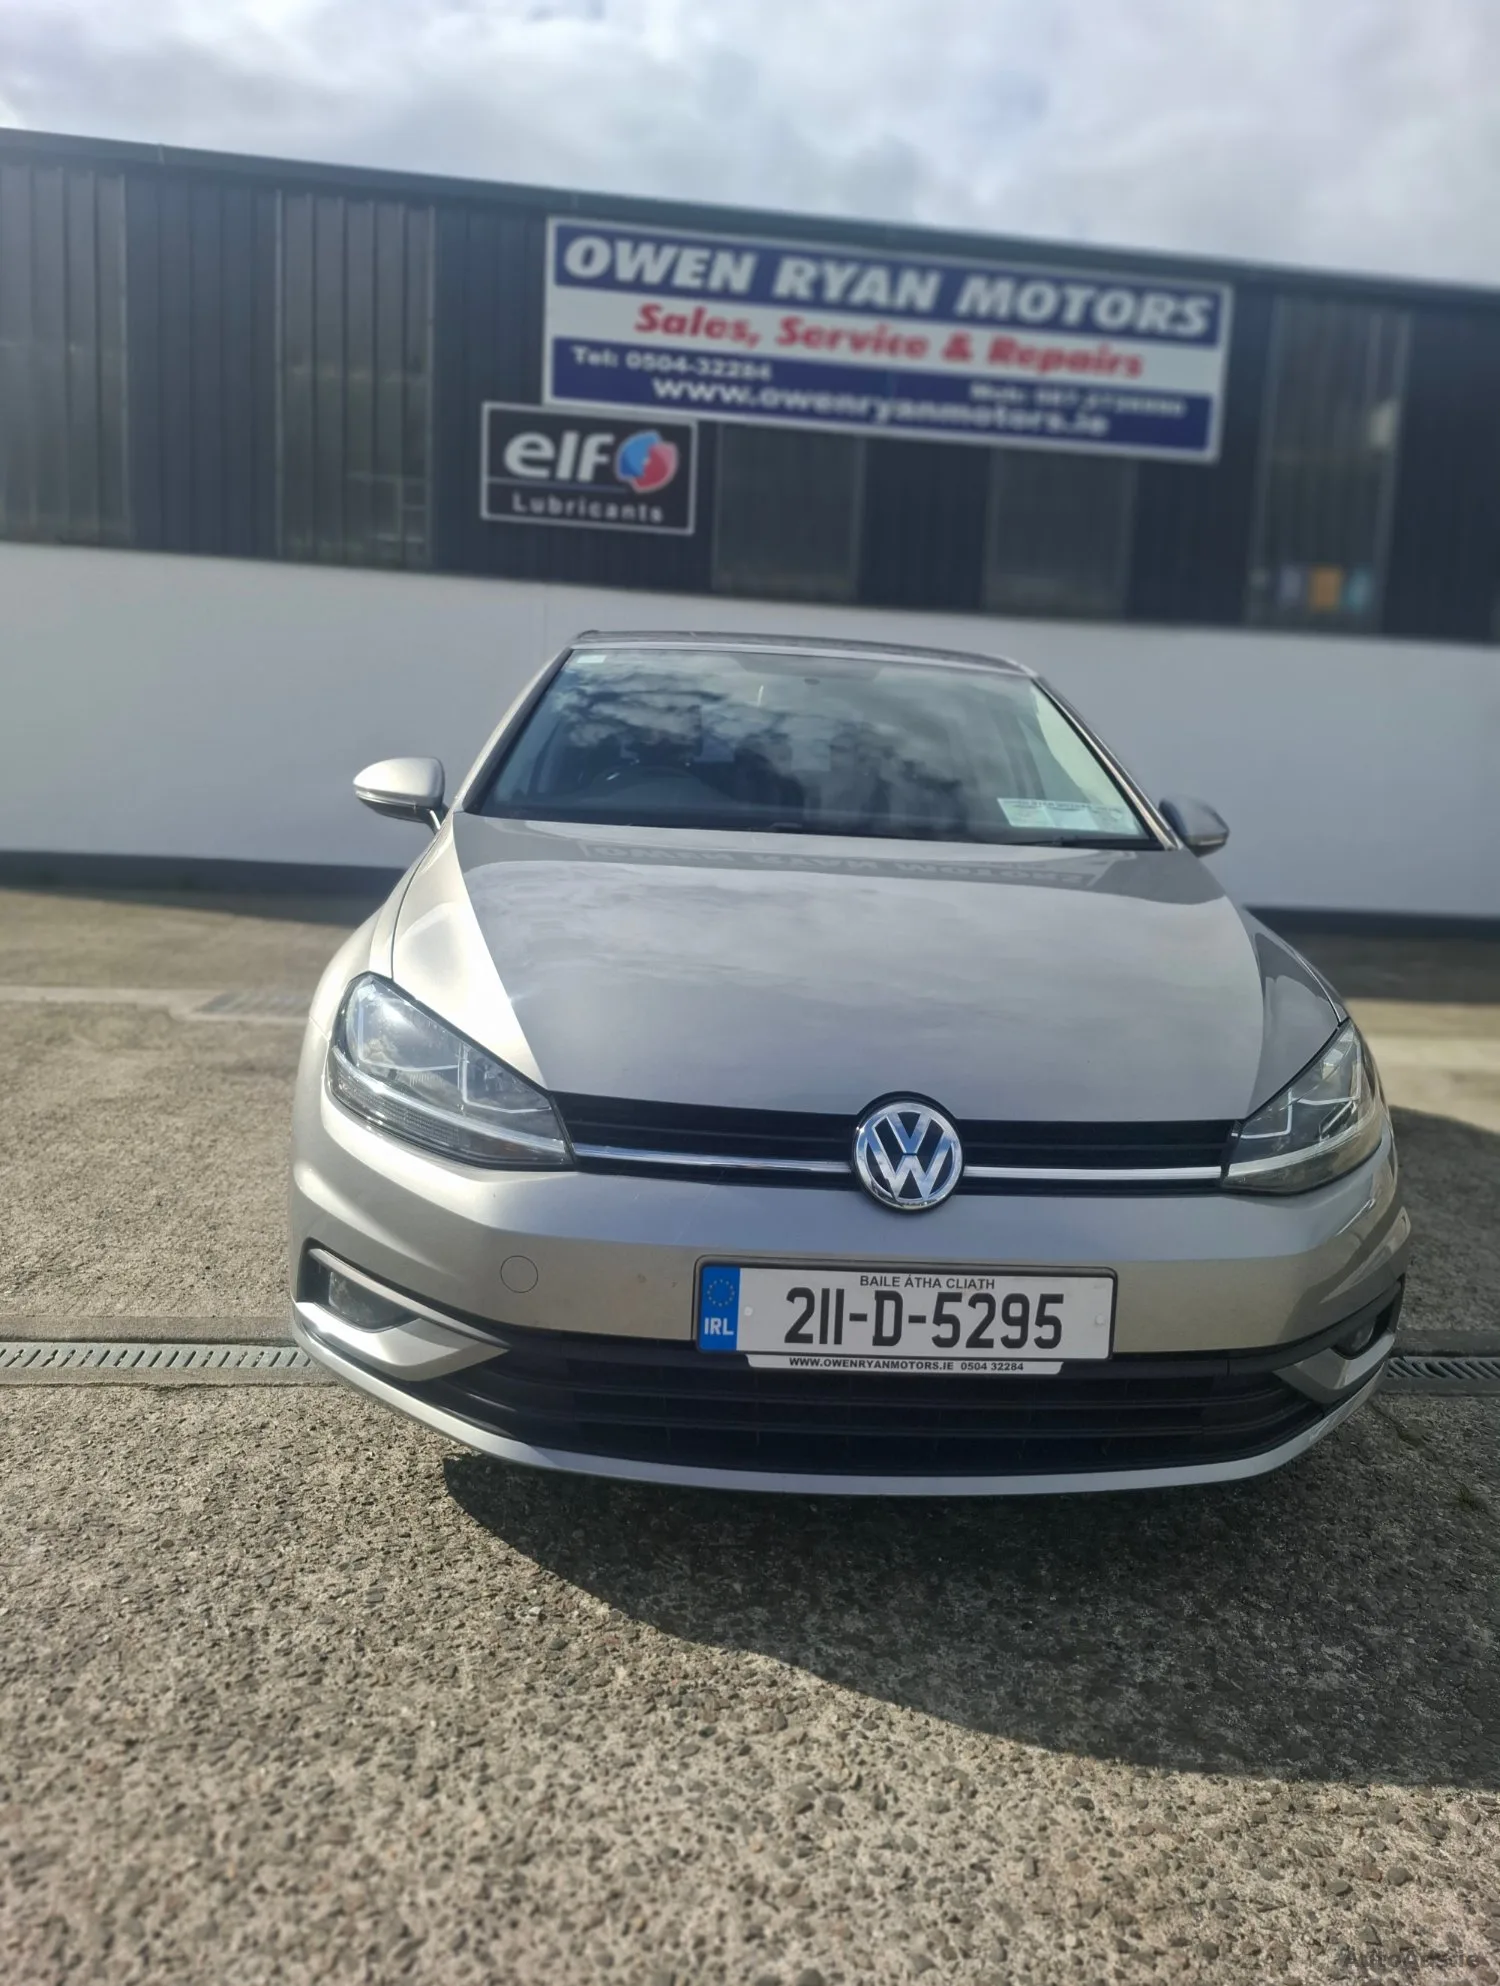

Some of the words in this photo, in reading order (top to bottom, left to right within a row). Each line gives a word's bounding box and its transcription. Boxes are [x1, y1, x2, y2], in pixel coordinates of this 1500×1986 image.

[564, 236, 758, 295] OWEN
[772, 255, 943, 313] RYAN
[954, 274, 1214, 337] MOTORS
[570, 345, 618, 369] Tel:
[635, 302, 761, 348] Sales,
[776, 316, 930, 361] Service
[942, 330, 973, 364] &
[986, 335, 1143, 379] Repairs
[652, 377, 1110, 436] www.owenryanmotors.ie
[504, 430, 615, 481] elf
[512, 491, 664, 524] Lubricants
[860, 1275, 901, 1287] BAILE
[904, 1274, 942, 1289] ÁTHA
[946, 1277, 995, 1290] CLIATH
[704, 1317, 734, 1336] IRL
[784, 1286, 1064, 1350] 211-D-5295
[789, 1357, 954, 1371] WWW.OWENRYANMOTORS.IE
[960, 1361, 988, 1371] 0504
[991, 1361, 1024, 1372] 32284
